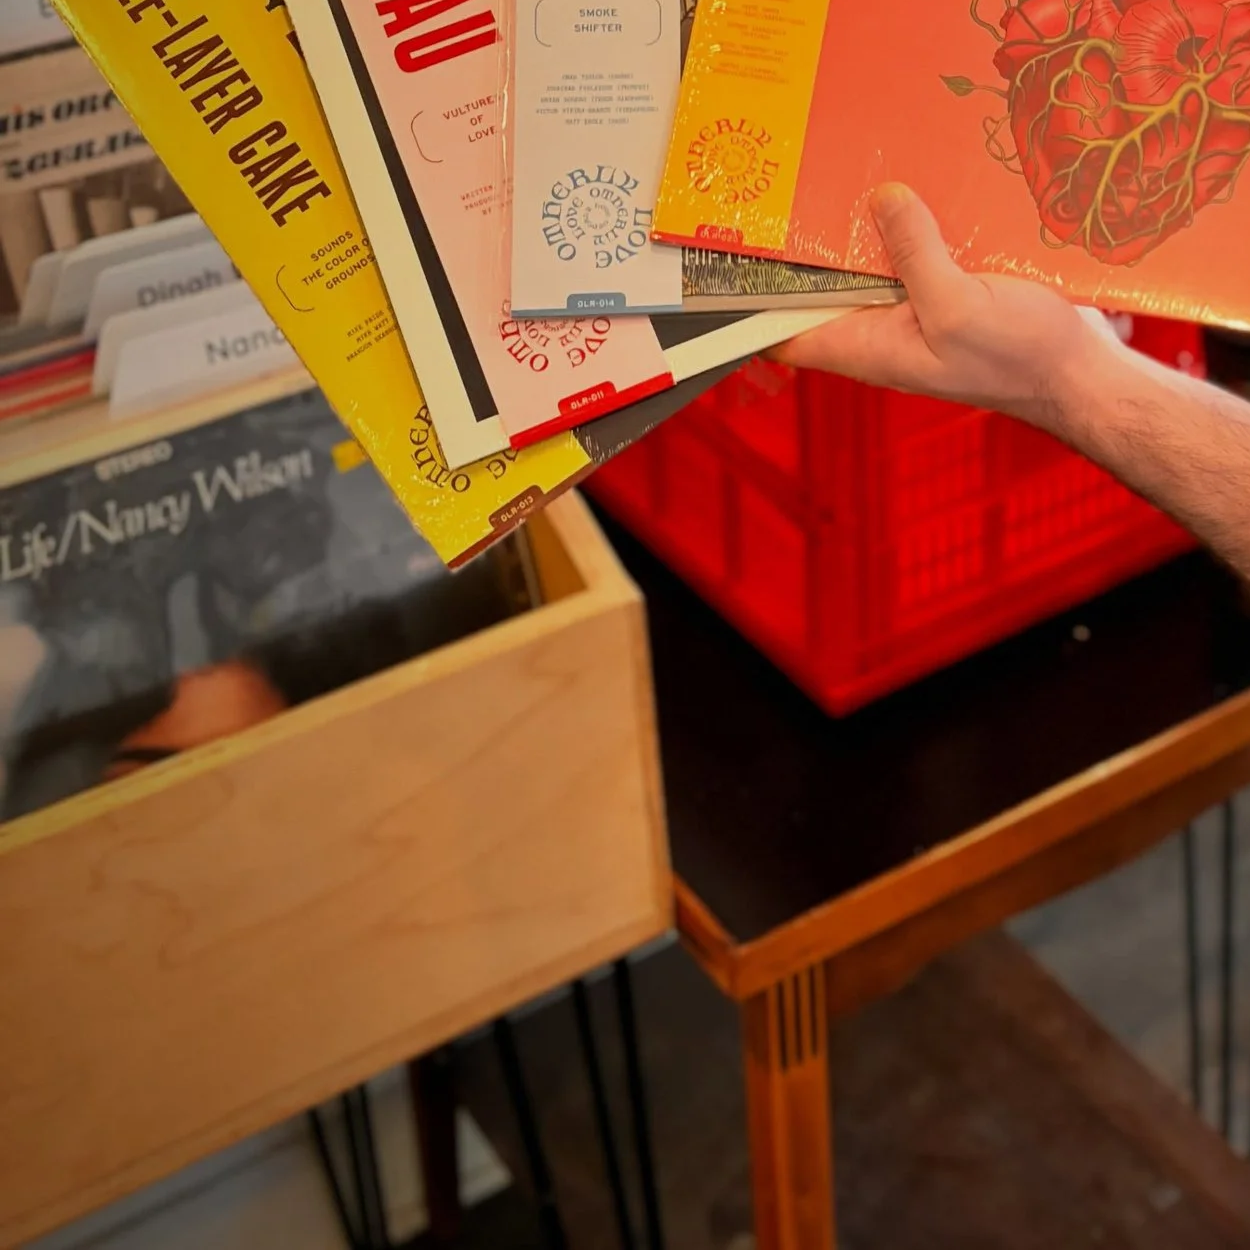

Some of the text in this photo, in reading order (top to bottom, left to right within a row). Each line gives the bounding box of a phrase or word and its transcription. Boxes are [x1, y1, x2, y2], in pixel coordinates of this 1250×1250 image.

[574, 23, 622, 33] SHIFTER
[579, 8, 618, 18] SMOKE
[468, 126, 497, 143] LOVE
[470, 114, 484, 126] OF
[228, 120, 332, 228] CAKE
[310, 231, 354, 262] SOUNDS
[302, 269, 324, 287] THE
[325, 244, 361, 271] COLOR
[325, 253, 376, 290] GROUNDS
[136, 268, 223, 308] Dinah
[206, 326, 287, 364] Nanc
[567, 316, 611, 368] OVE
[192, 450, 313, 512] Wilson
